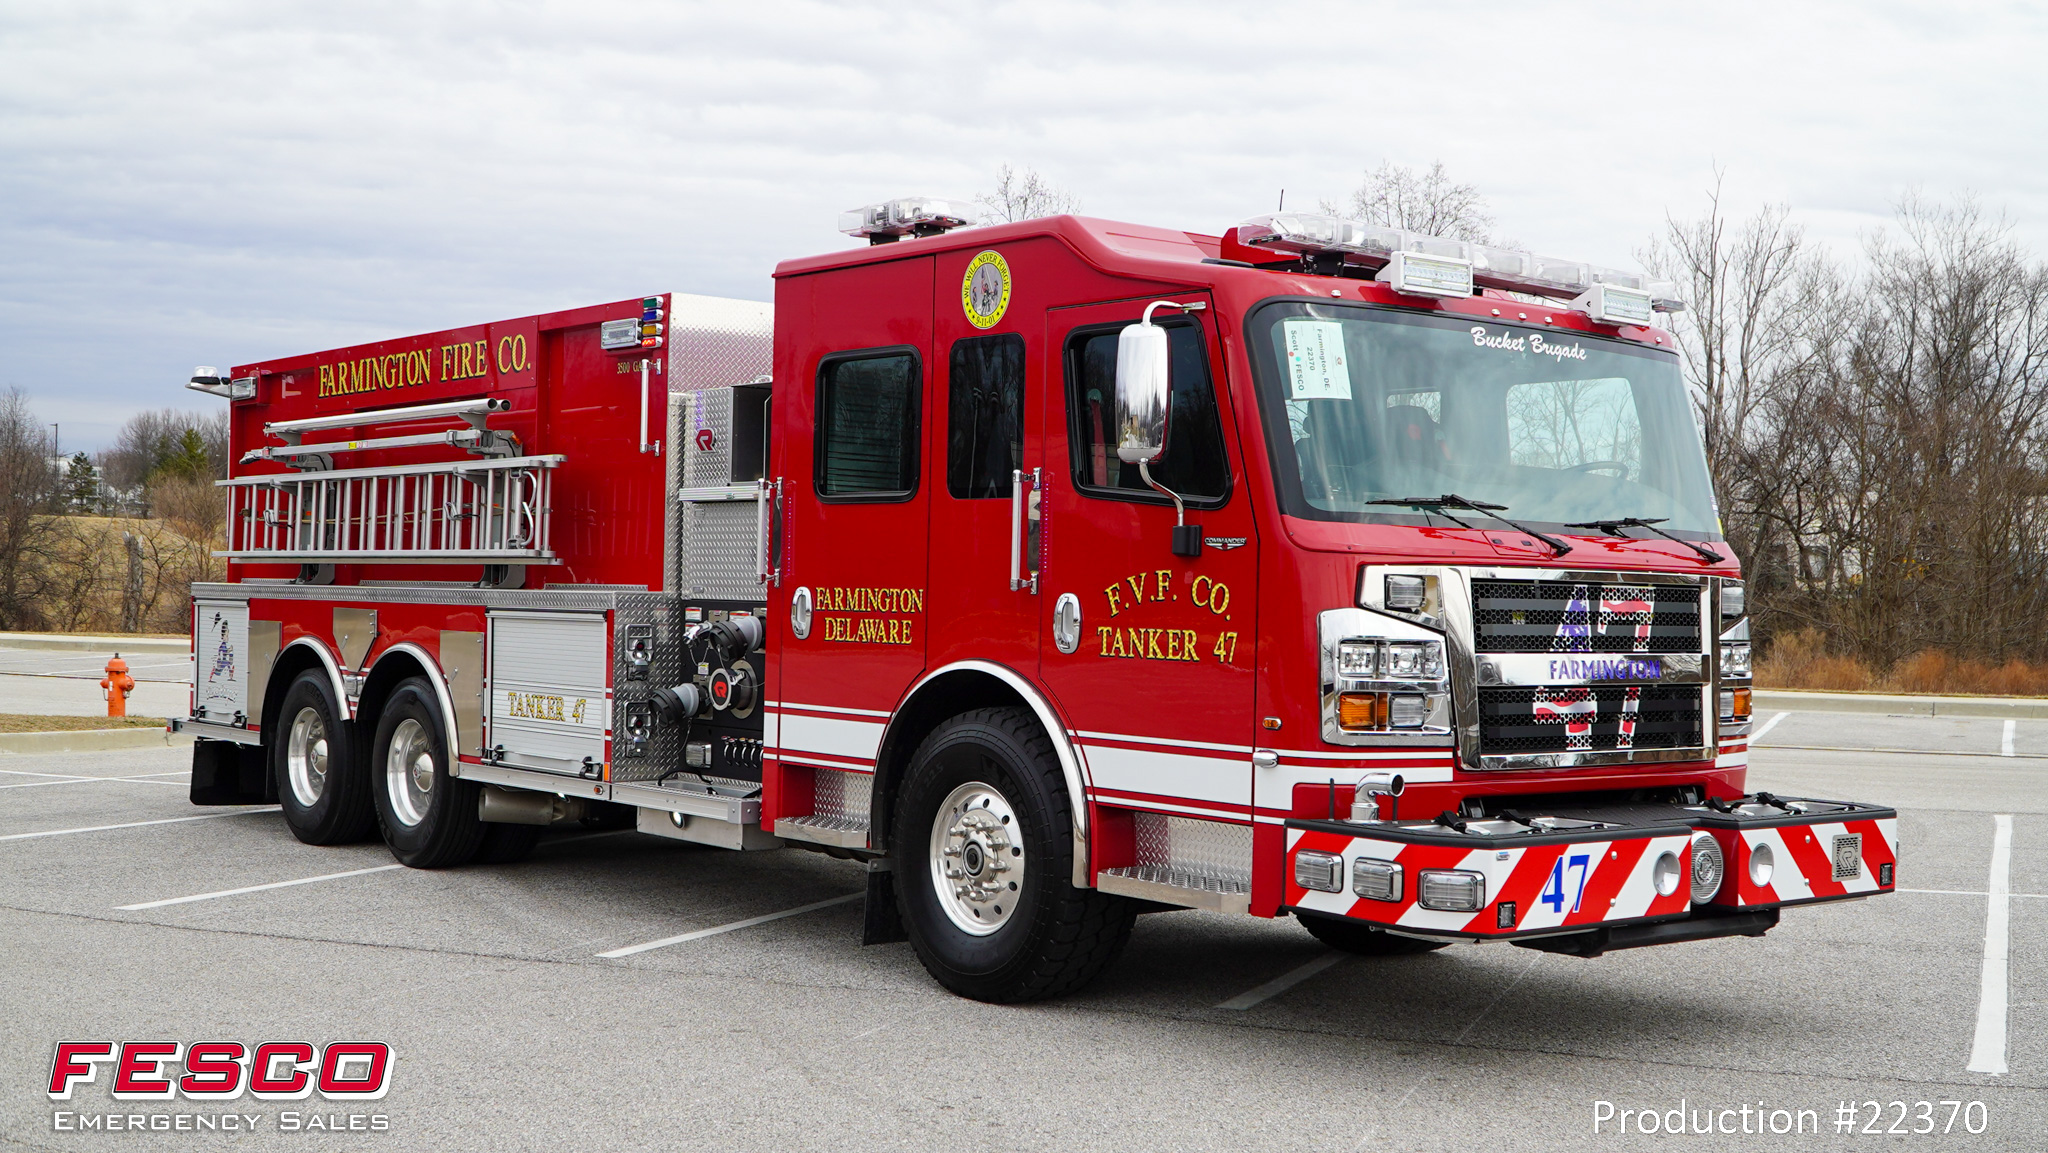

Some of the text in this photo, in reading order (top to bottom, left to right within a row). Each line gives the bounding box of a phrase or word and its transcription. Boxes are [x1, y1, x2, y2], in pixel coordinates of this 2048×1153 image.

[963, 253, 1010, 299] WE WILL NEVER FORGET
[975, 315, 996, 327] 9-11-01
[1306, 346, 1315, 371] 22370
[1470, 326, 1588, 362] Bucket Brigade
[318, 334, 532, 398] FARMINGTON FIRE CO.
[1296, 364, 1304, 391] FESCO
[815, 587, 924, 614] FARMINGTON
[1104, 569, 1232, 621] F.V.F. CO.
[824, 617, 913, 645] DELAWARE
[1097, 625, 1238, 664] TANKER 47
[1549, 659, 1662, 680] FARMINGTON
[507, 692, 587, 724] TANKER 47
[1541, 854, 1590, 914] 47
